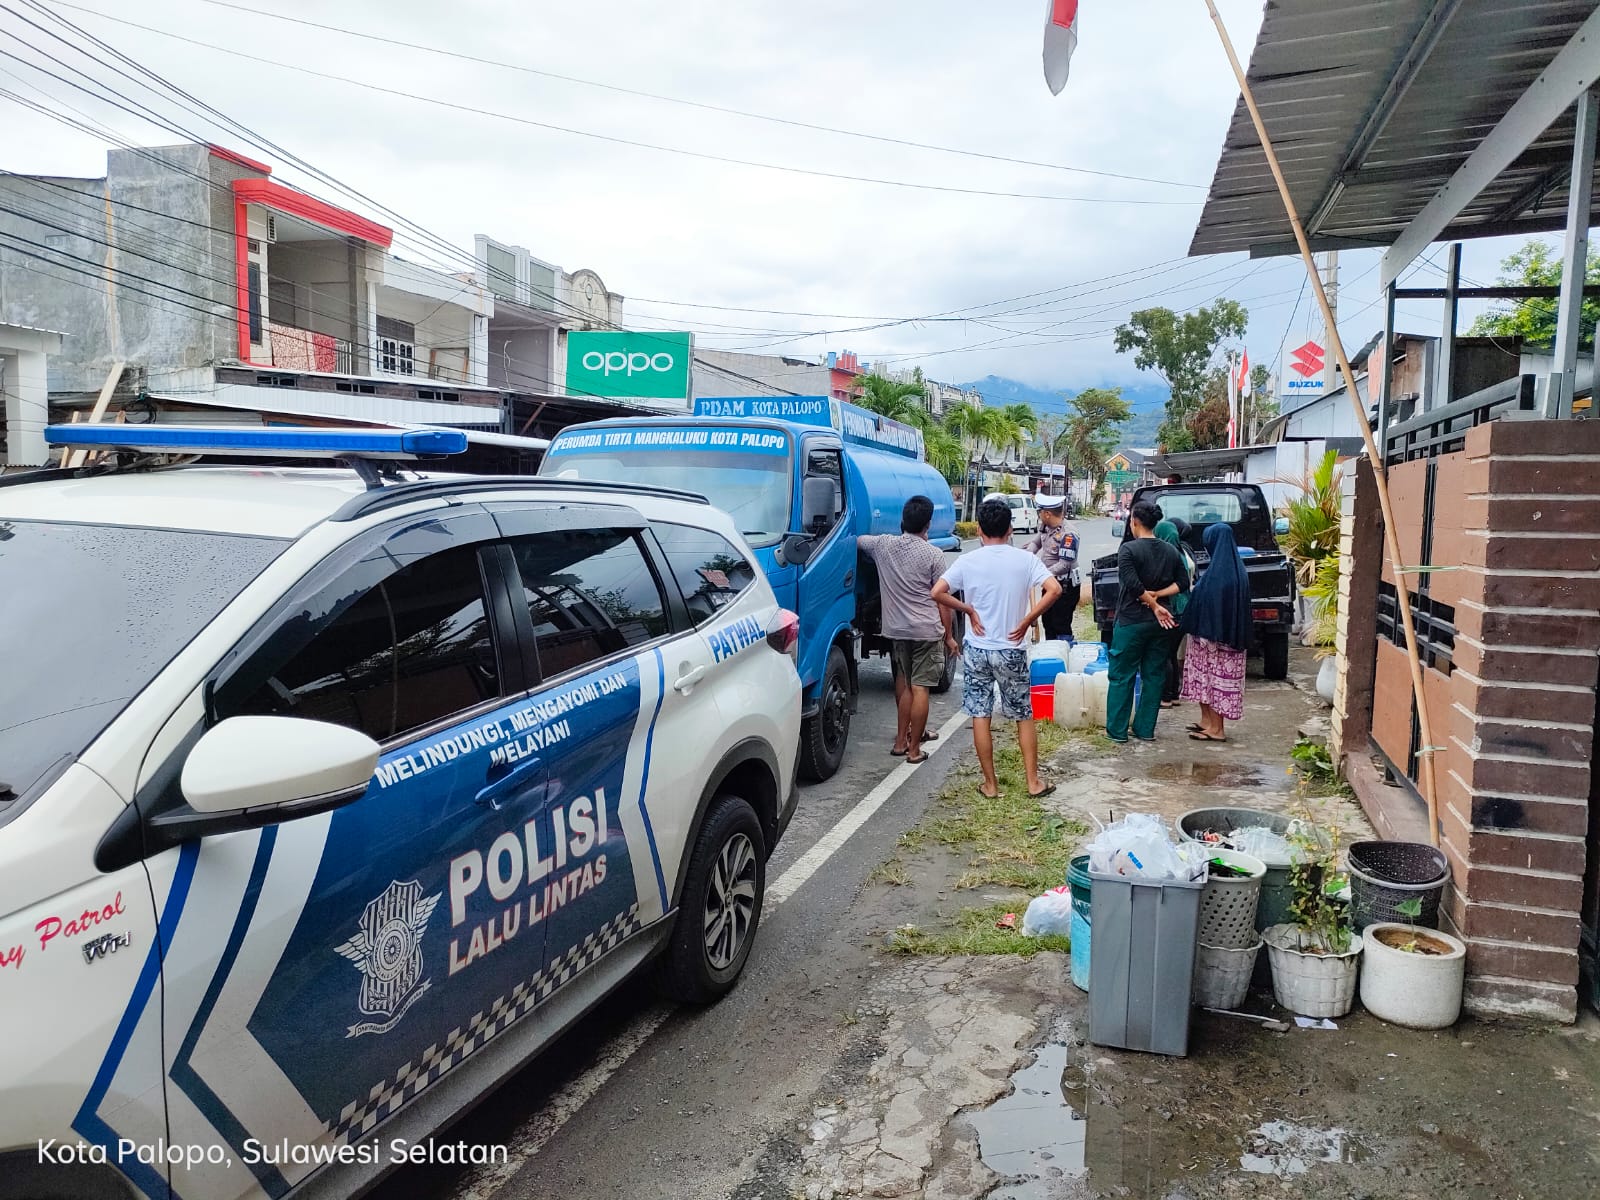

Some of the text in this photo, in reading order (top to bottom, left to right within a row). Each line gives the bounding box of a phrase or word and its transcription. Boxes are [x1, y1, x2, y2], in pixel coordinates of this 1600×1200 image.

[582, 351, 674, 377] oppo
[700, 400, 821, 416] PDAM KOTA PALOPO
[554, 431, 785, 452] PERUMDA TIRTA MANGKALUKU KOTA PALOPO
[707, 614, 766, 665] PATWAL
[374, 672, 628, 789] MELINDUNGI, MENGAYOMI DAN
[489, 719, 571, 768] MELAYANI
[450, 787, 608, 928] POLISI
[35, 891, 126, 951] Patrol
[449, 903, 521, 976] LALU
[528, 854, 607, 927] LINTAS
